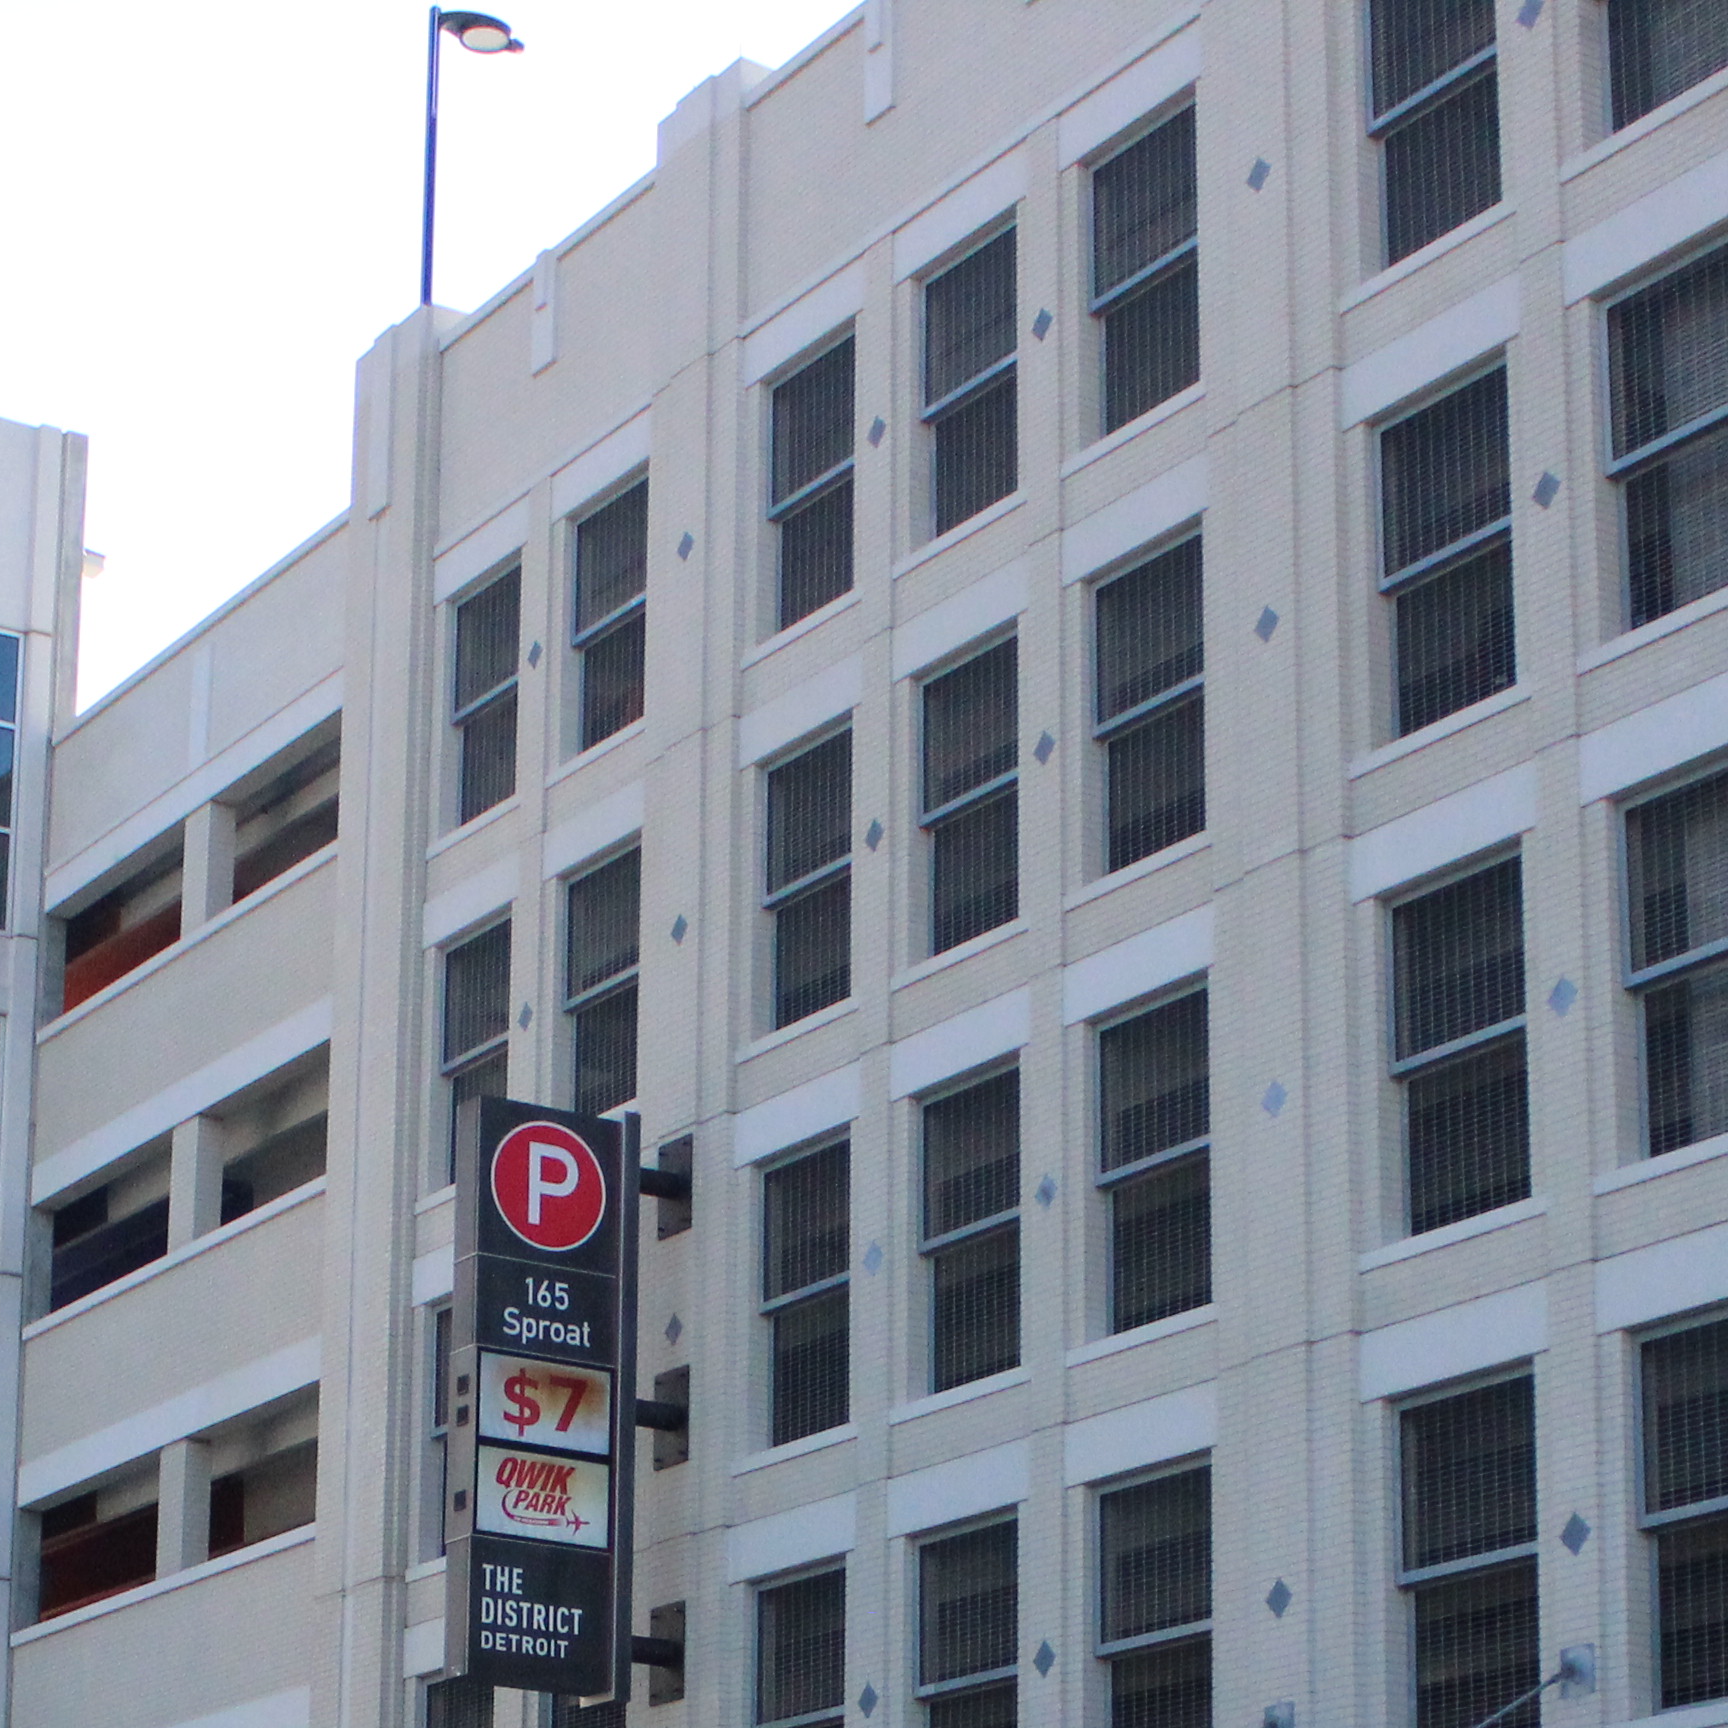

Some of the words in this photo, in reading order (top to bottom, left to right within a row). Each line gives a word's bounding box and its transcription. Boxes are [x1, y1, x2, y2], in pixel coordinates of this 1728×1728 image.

[528, 1140, 580, 1226] P
[525, 1277, 570, 1311] 165
[502, 1306, 591, 1348] Sproat
[503, 1367, 589, 1438] $7
[495, 1456, 576, 1496] QWIK
[512, 1489, 573, 1517] PARK
[481, 1562, 524, 1595] THE
[480, 1596, 583, 1636] DISTRICT
[480, 1630, 569, 1659] DETROIT
